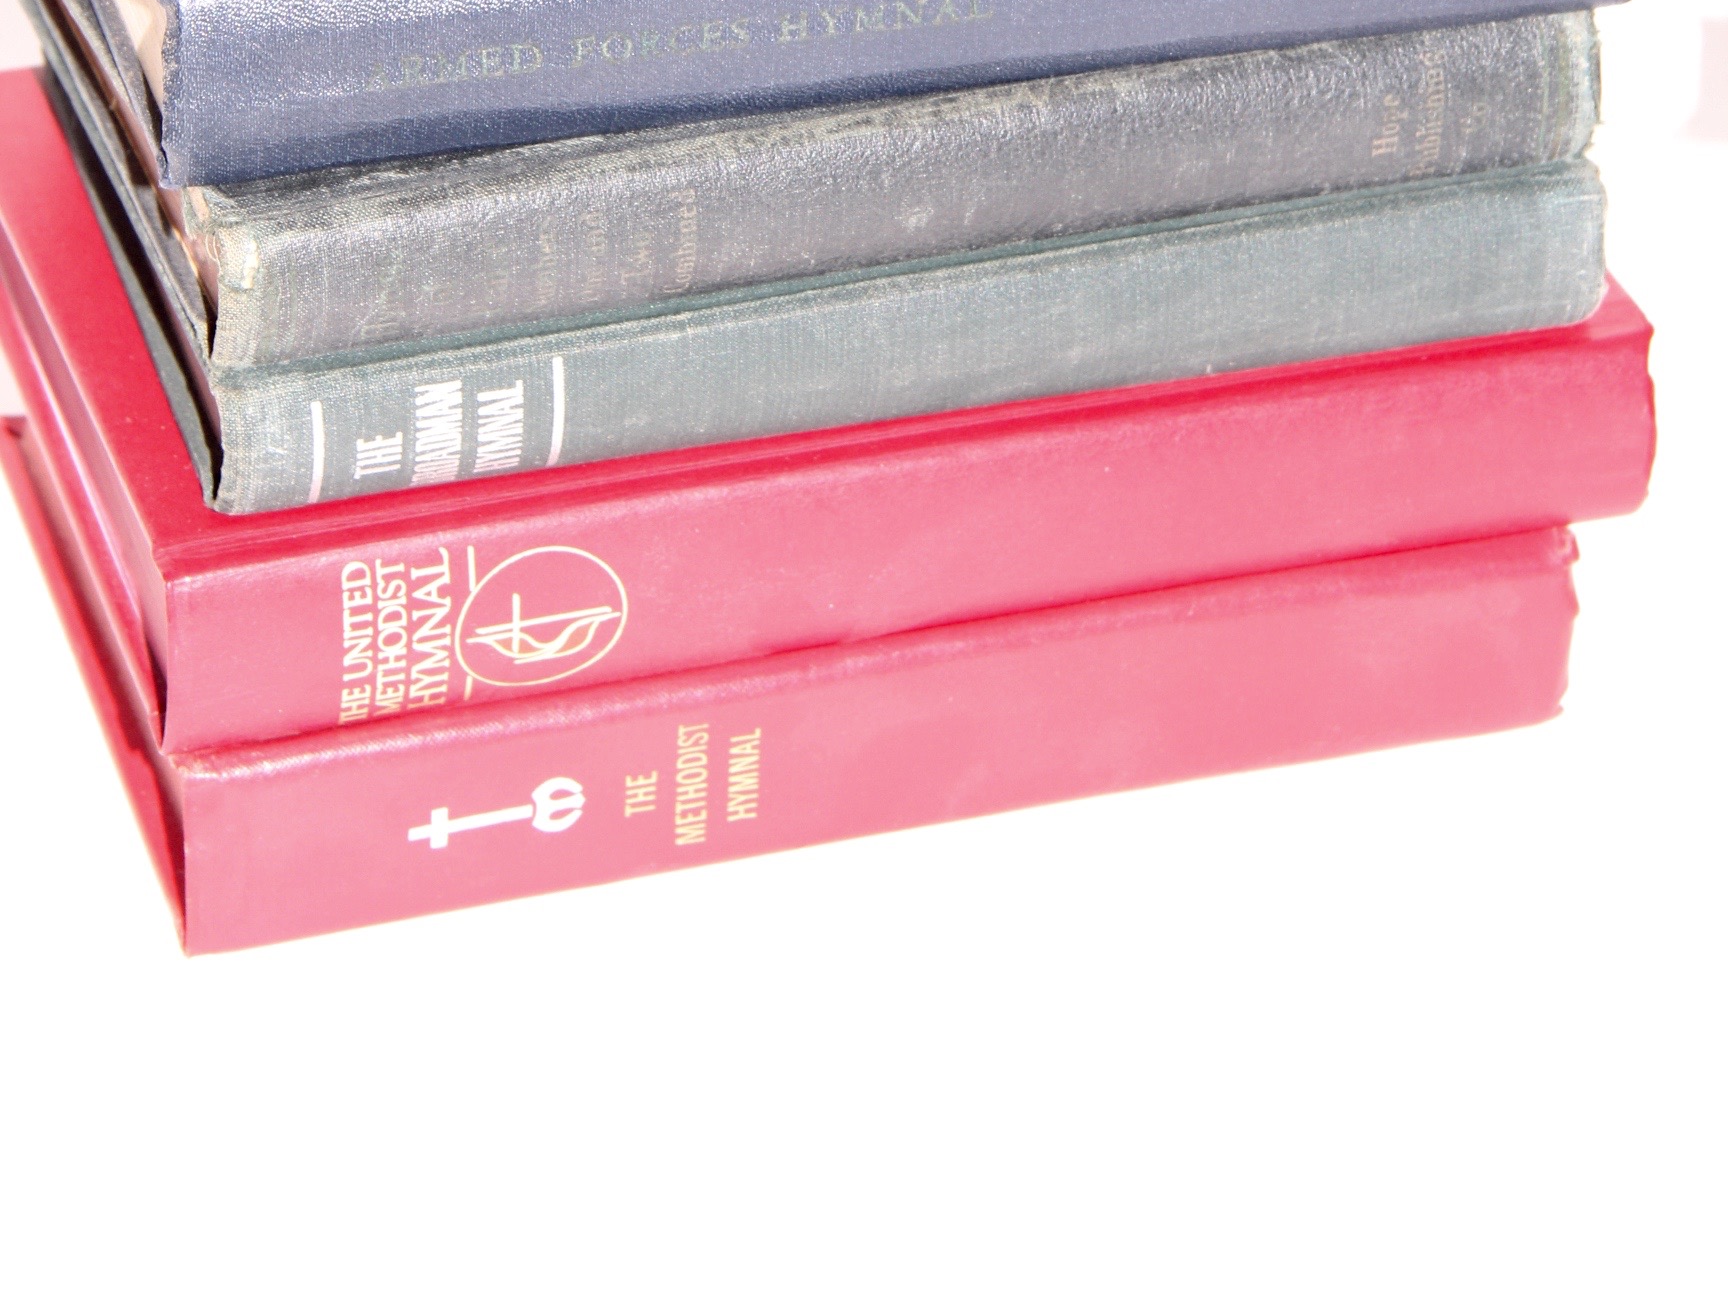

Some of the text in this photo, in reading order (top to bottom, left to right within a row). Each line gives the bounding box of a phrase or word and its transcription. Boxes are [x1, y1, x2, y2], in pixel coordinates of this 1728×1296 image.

[366, 41, 542, 92] ARMED
[570, 17, 752, 68] FORCES
[1371, 93, 1410, 157] Hope
[662, 188, 698, 293] Combined
[354, 432, 402, 479] THE
[473, 380, 524, 473] HYMNAL
[339, 561, 373, 725] THE UNITED
[374, 558, 407, 717] METHODIST
[408, 547, 451, 709] HYMNAL
[625, 770, 658, 817] THE
[674, 724, 710, 845] METHODIST
[727, 728, 761, 822] HYMNAL
